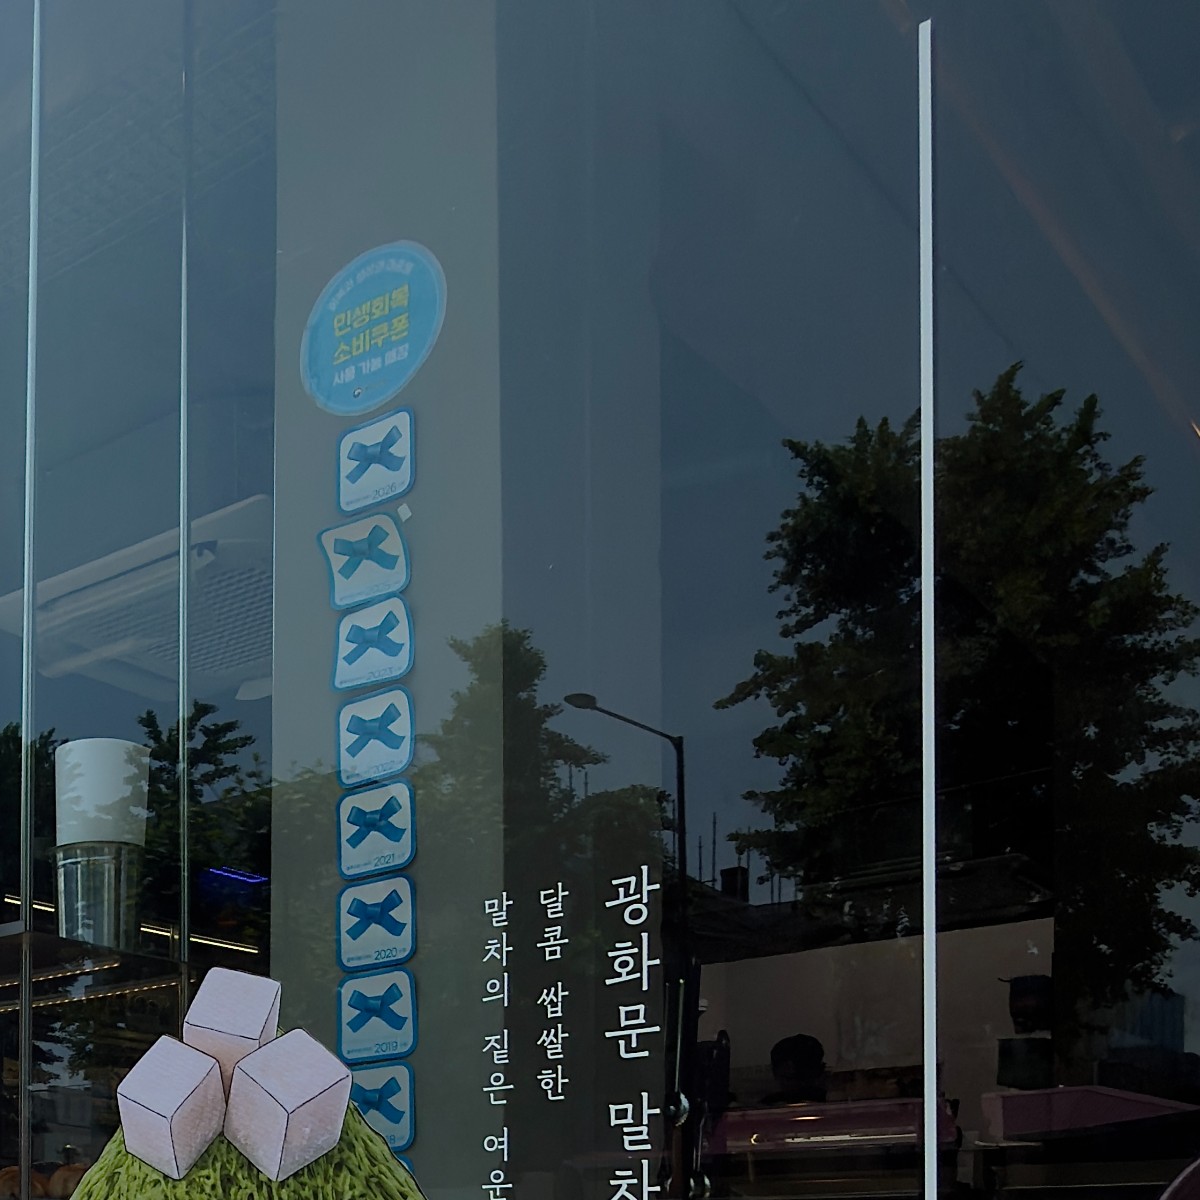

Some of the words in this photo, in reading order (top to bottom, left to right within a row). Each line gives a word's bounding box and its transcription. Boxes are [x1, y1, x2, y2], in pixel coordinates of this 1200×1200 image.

[333, 284, 409, 337] 민생회복
[332, 313, 409, 365] 소비쿠폰
[372, 482, 397, 501] 2026
[373, 853, 395, 867] 2021
[535, 881, 569, 962] 달콤
[374, 948, 397, 961] 2020
[480, 890, 514, 1009] 말차의
[603, 864, 661, 1062] 광화문
[374, 1041, 398, 1054] 2019
[535, 980, 569, 1102] 쌉쌀한
[480, 1030, 514, 1107] 짙은
